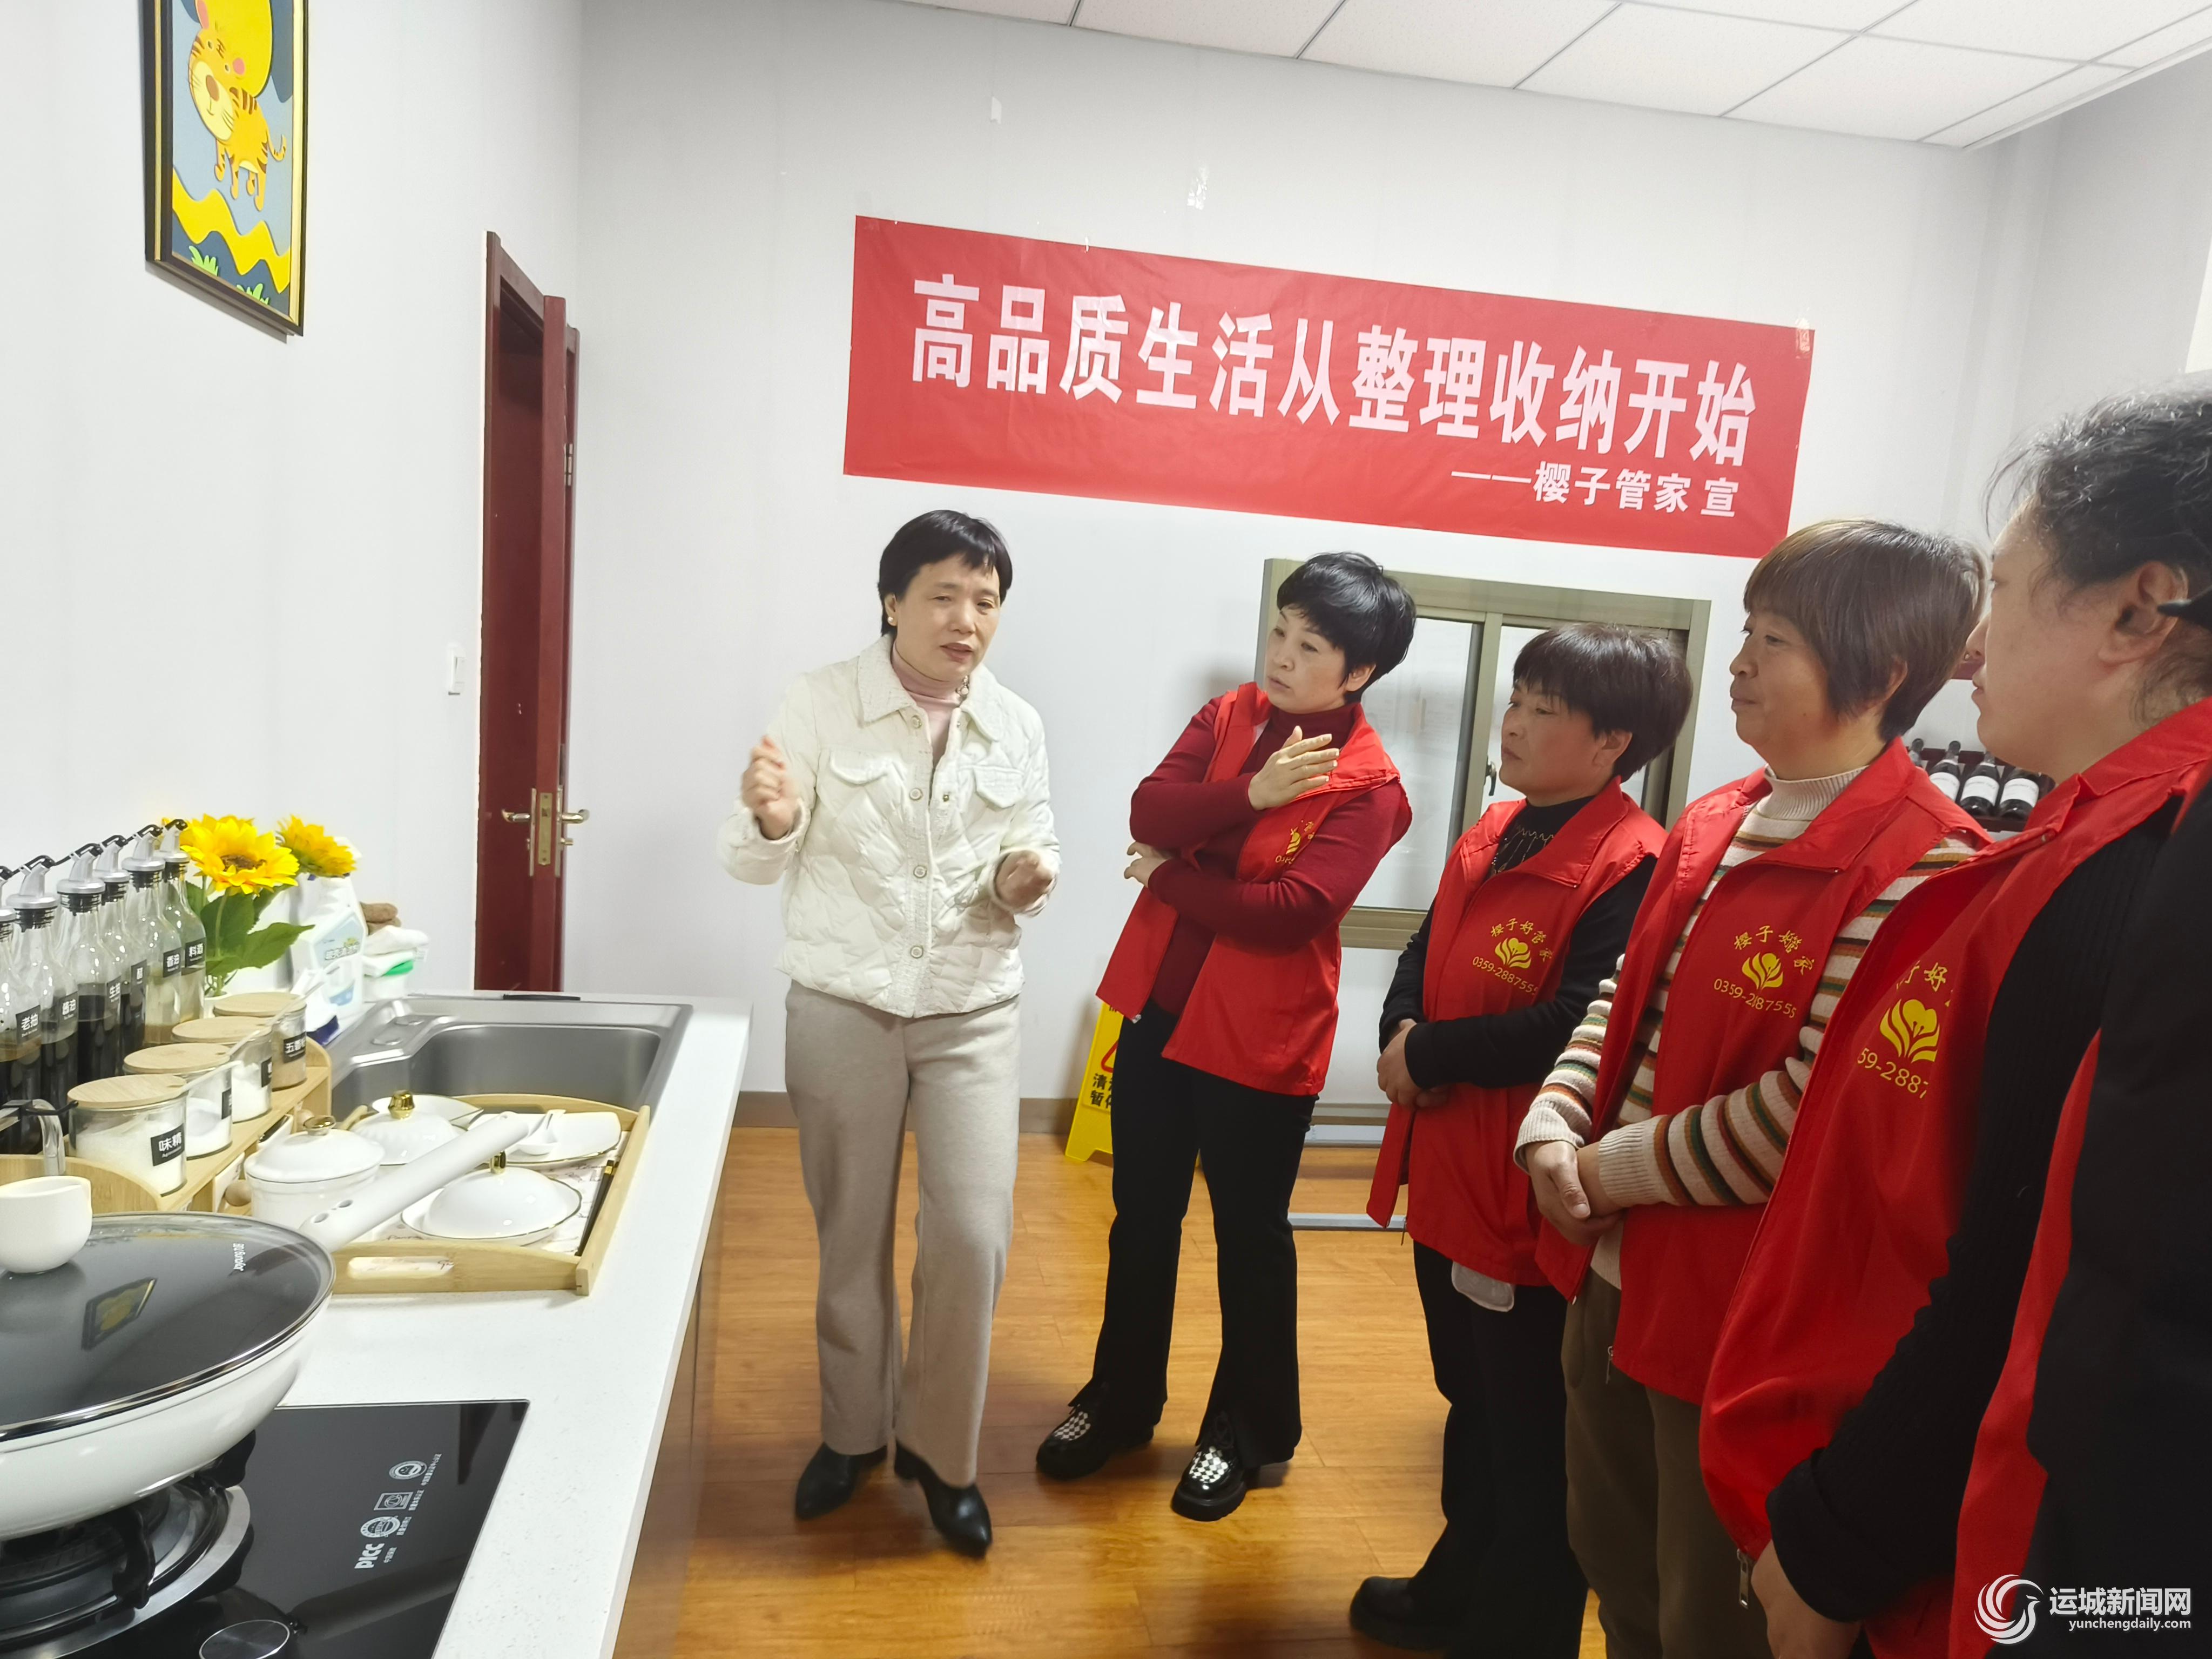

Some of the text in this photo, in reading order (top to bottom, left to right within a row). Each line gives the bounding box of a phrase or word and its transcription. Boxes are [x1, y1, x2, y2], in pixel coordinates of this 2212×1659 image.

[913, 274, 1756, 467] 高品质生活从整理收纳开始
[1700, 477, 1739, 517] 宣
[1714, 978, 1797, 1018] 0359-287555
[21, 1014, 38, 1030] 老抽
[159, 1131, 182, 1151] 味精
[354, 1543, 385, 1569] PICC
